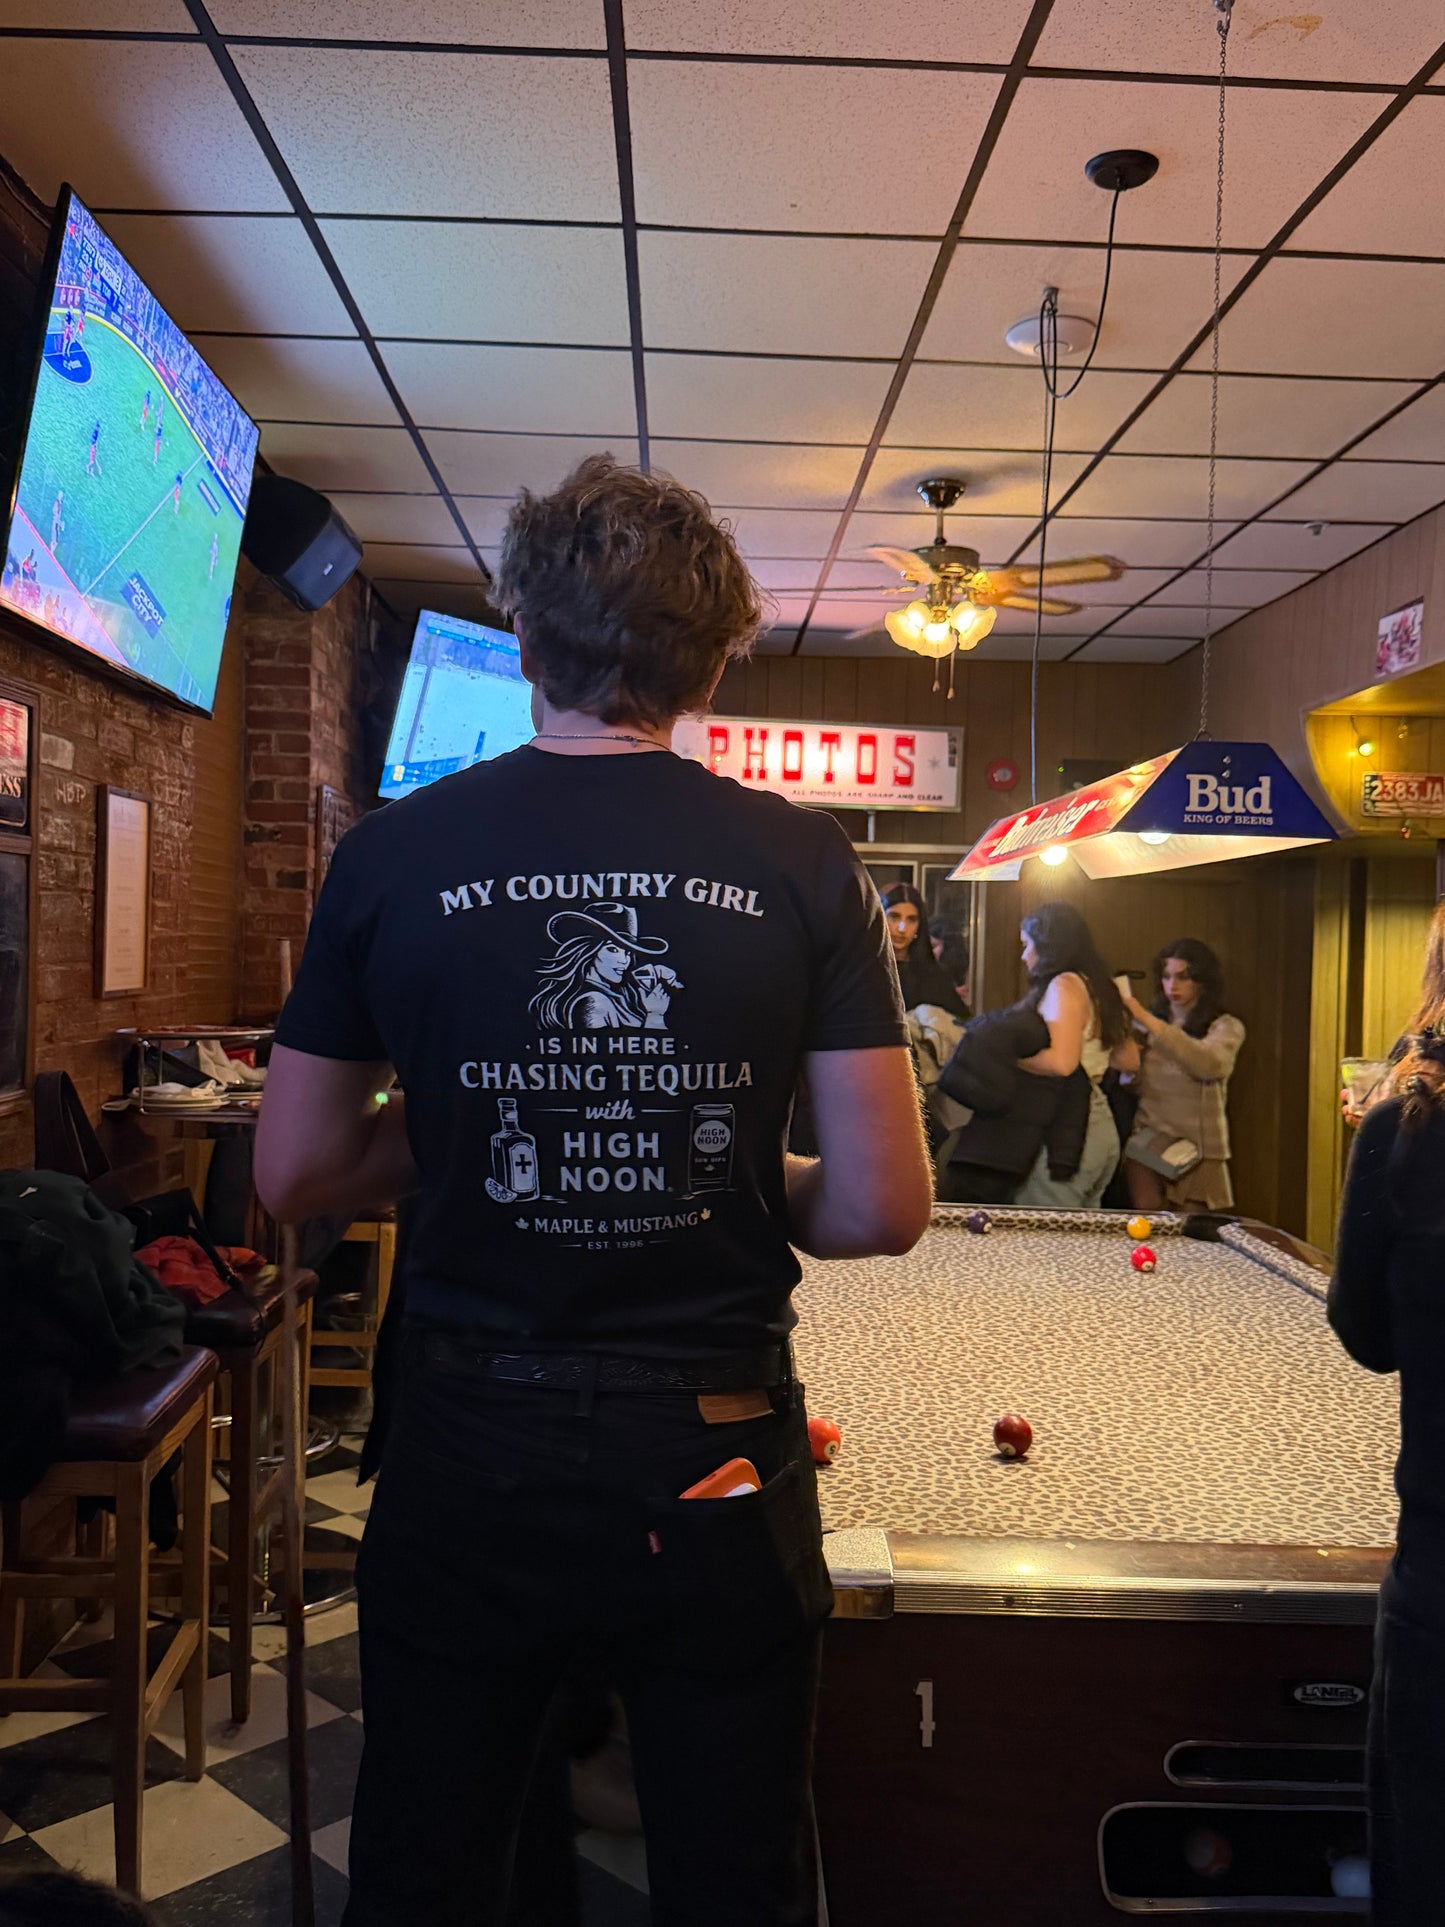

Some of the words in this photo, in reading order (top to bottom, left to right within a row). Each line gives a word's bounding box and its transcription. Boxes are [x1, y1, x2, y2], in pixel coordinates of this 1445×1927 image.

[129, 577, 164, 625] JACKPOT
[132, 595, 152, 622] CITY
[708, 726, 915, 787] PHOTOS
[1185, 774, 1273, 814] Bud
[1183, 814, 1213, 824] KING
[1215, 815, 1232, 824] OF
[1234, 816, 1274, 826] BEERS
[438, 879, 495, 916] MY
[505, 872, 677, 901] COUNTRY
[683, 877, 765, 918] GIRL
[539, 1037, 562, 1055] IS
[572, 1037, 598, 1055] IN
[608, 1037, 676, 1055] HERE
[459, 1062, 607, 1091] CHASING
[616, 1062, 753, 1096] TEQUILA
[585, 1099, 636, 1120] with
[563, 1132, 660, 1159] HIGH
[697, 1136, 727, 1145] NOON
[700, 1128, 726, 1136] HIGH
[535, 1218, 594, 1234] MAPLE
[597, 1220, 609, 1234] &
[614, 1211, 699, 1234] MUSTANG
[915, 1679, 936, 1748] 1
